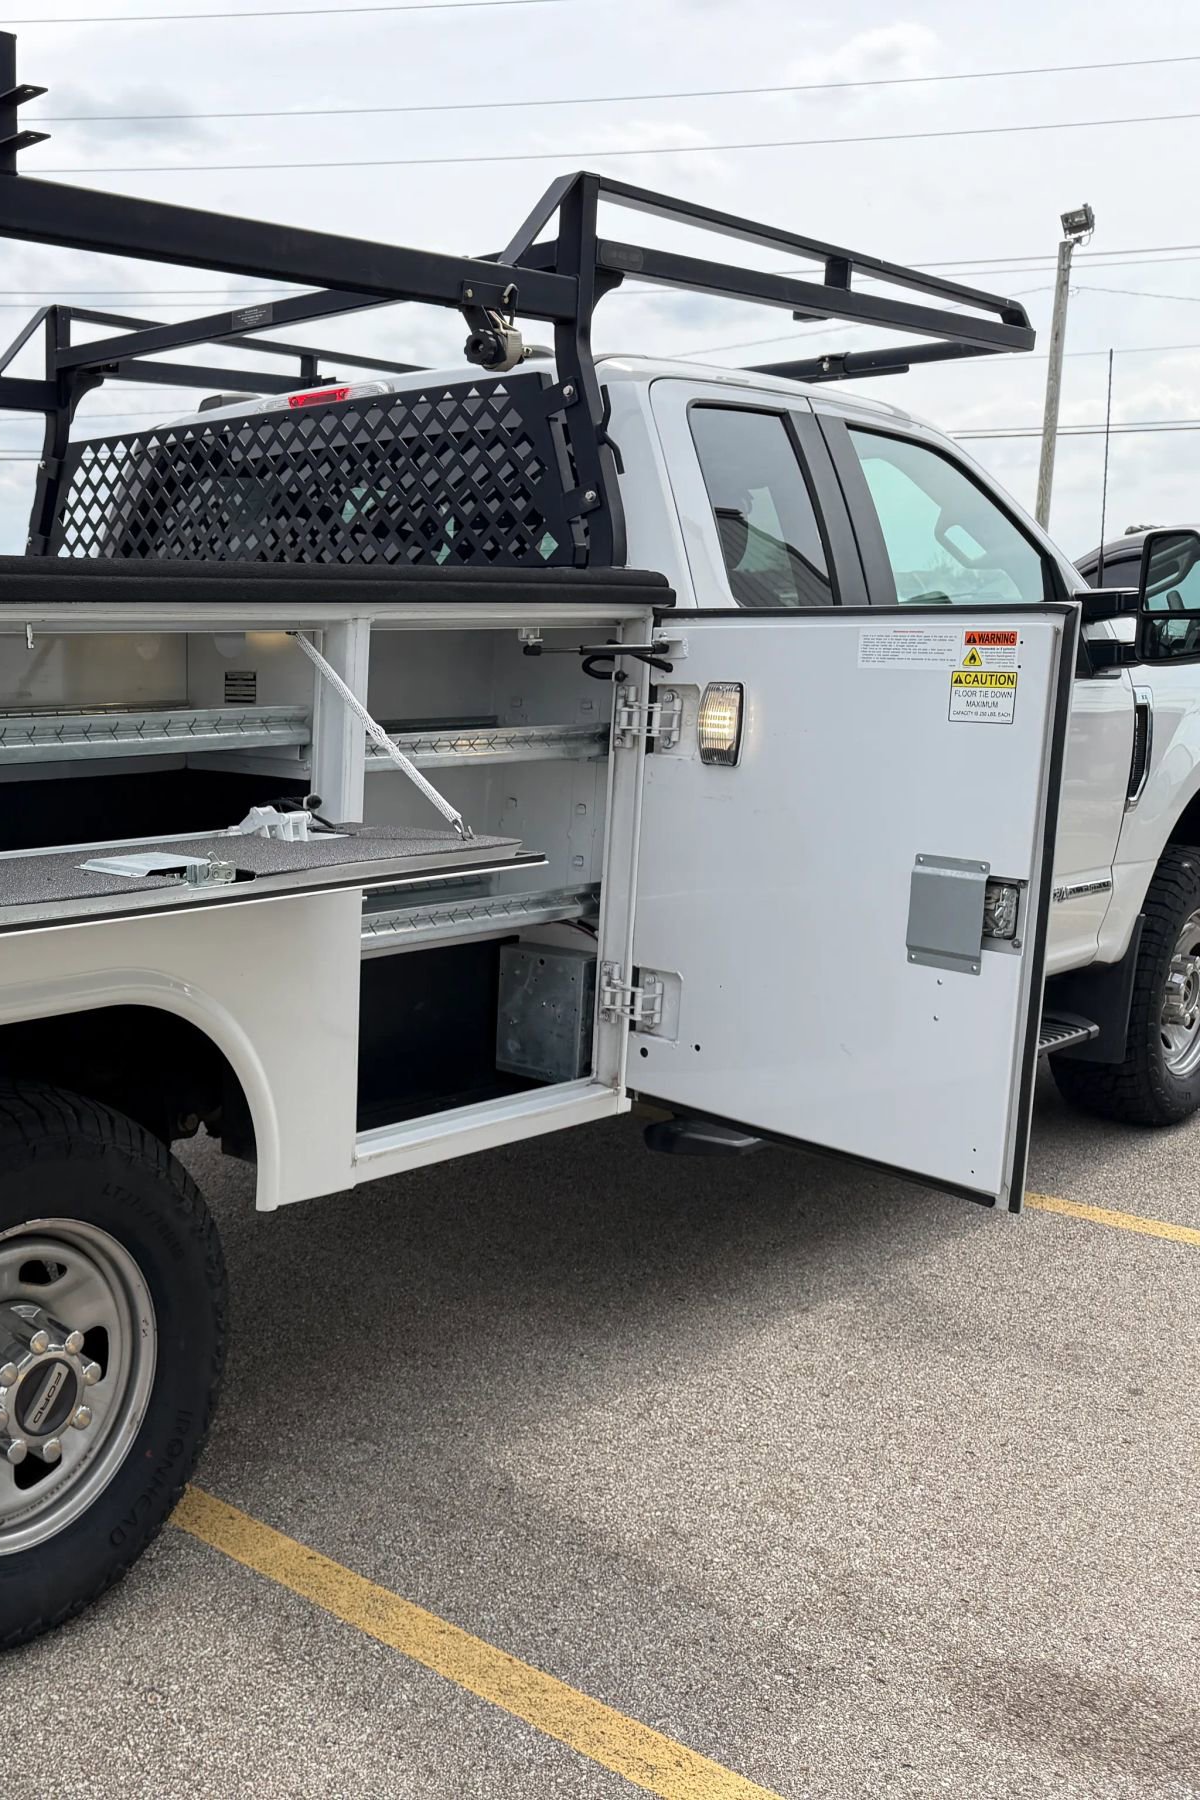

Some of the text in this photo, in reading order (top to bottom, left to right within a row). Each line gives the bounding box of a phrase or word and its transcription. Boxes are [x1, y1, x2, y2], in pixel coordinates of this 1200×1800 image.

[978, 633, 1015, 644] WARNING
[964, 673, 1015, 686] CAUTION
[954, 689, 1013, 699] FLOOR TIE DOWN
[965, 700, 999, 708] MAXIMUM
[32, 1371, 62, 1425] FORD
[108, 1408, 194, 1548] IRONHEAD
